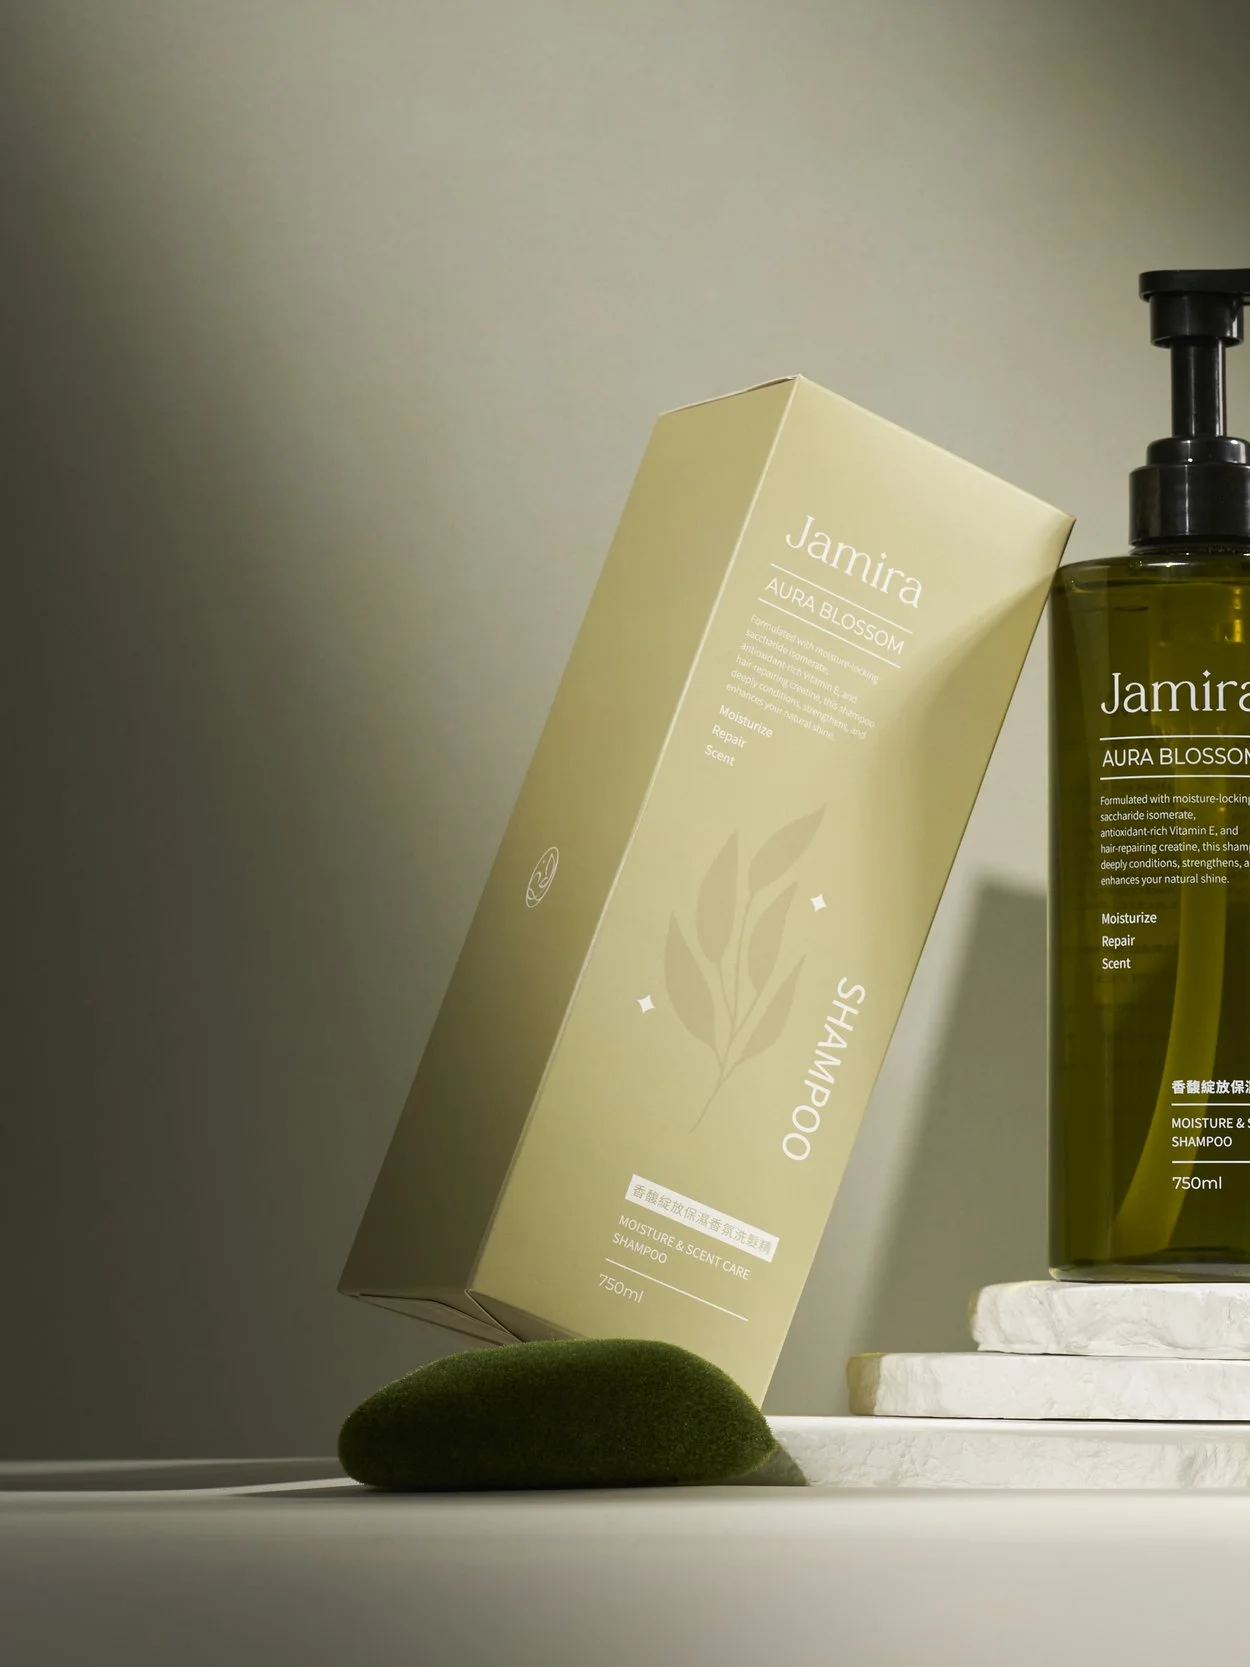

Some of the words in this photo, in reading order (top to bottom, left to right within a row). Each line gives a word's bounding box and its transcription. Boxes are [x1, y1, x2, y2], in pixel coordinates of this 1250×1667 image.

[785, 515, 922, 608] Jamira
[764, 577, 815, 613] AURA
[819, 602, 905, 655] BLOSSOM
[719, 705, 773, 738] Moisturize
[712, 725, 748, 749] Repair
[704, 744, 735, 767] Scent
[1103, 748, 1153, 767] AURA
[1101, 794, 1148, 805] Formulated
[1150, 794, 1170, 803] with
[1100, 810, 1144, 821] saccharide
[1147, 810, 1196, 820] isomerate,
[1101, 826, 1168, 838] antioxidant-rich
[1169, 826, 1206, 835] Vitamin
[1209, 826, 1217, 836] E,
[1220, 826, 1238, 835] and
[1101, 843, 1158, 854] hair-repairing
[1159, 842, 1200, 852] creatine,
[1203, 842, 1220, 851] this
[1101, 859, 1128, 871] deeply
[1129, 858, 1181, 868] conditions,
[1182, 858, 1242, 870] strengthens,
[1101, 876, 1141, 886] enhances
[1141, 876, 1162, 886] your
[1165, 874, 1200, 883] natural
[1201, 874, 1229, 883] shine.
[1102, 912, 1157, 924] Moisturize
[1102, 935, 1135, 949] Repair
[1102, 958, 1131, 969] Scent
[782, 976, 866, 1161] SHAMPOO
[1172, 1118, 1233, 1128] MOISTURE
[1236, 1118, 1244, 1128] &
[1172, 1136, 1232, 1147] SHAMPOO
[1173, 1176, 1221, 1189] 750ml
[612, 1233, 668, 1264] SHAMPOO
[618, 1215, 676, 1248] MOISTURE
[675, 1240, 684, 1252] &
[685, 1244, 722, 1267] SCENT
[722, 1260, 751, 1281] CARE
[598, 1273, 644, 1303] 750ml
